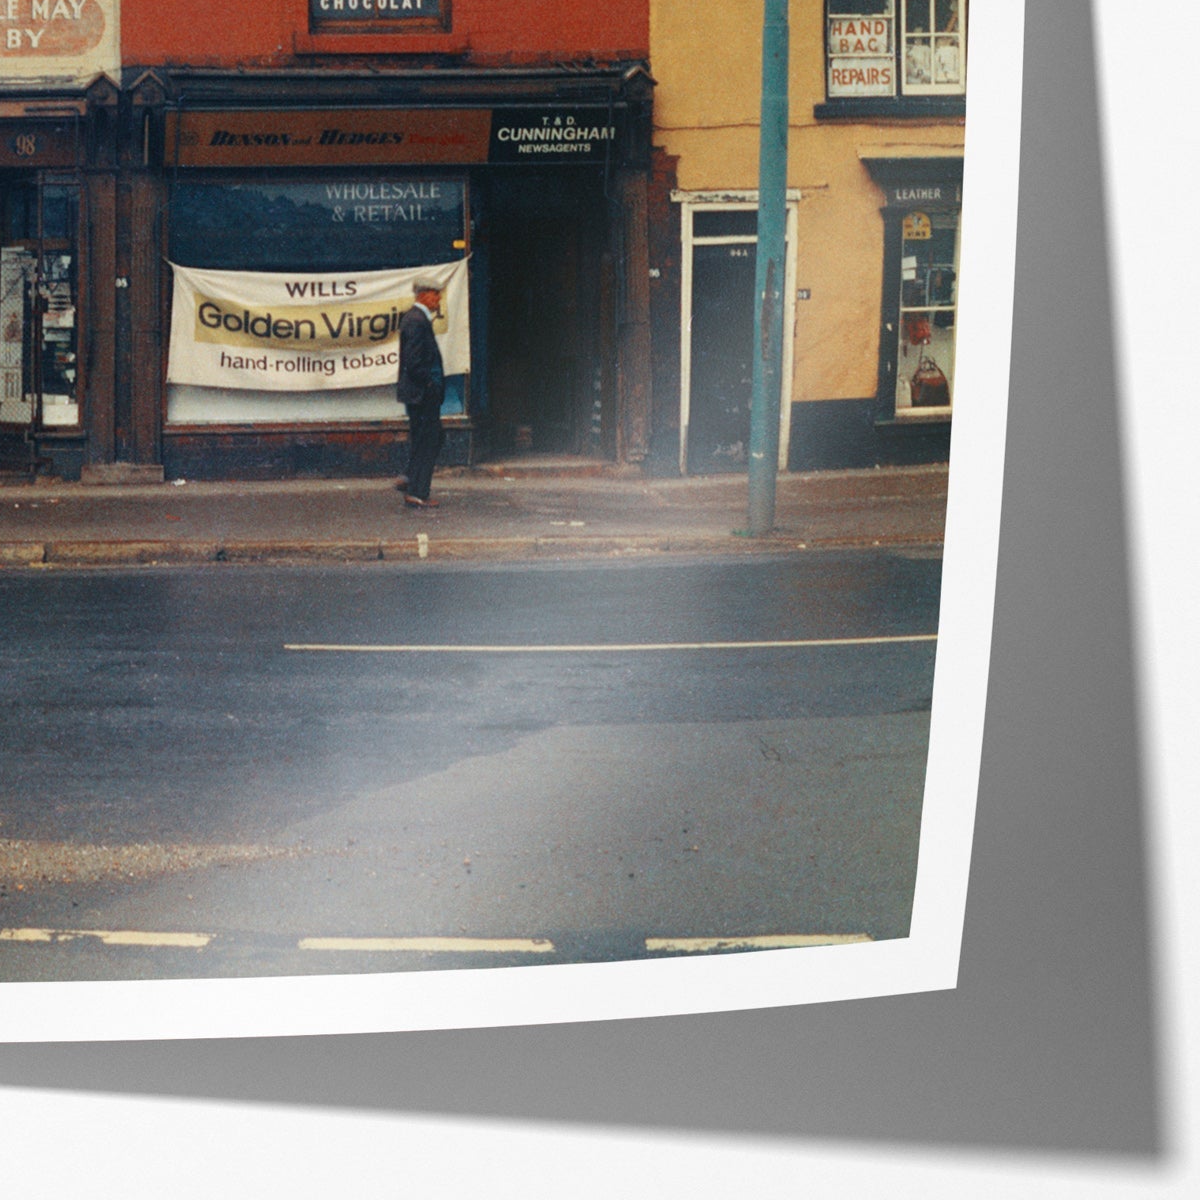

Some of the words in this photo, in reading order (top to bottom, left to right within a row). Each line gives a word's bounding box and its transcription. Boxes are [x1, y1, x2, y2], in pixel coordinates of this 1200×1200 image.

[832, 21, 885, 36] HAND
[7, 29, 45, 48] BY
[832, 68, 891, 86] REPAIRS
[554, 117, 562, 125] &
[518, 143, 591, 153] NEWSAGENTS
[326, 183, 441, 200] WHOLESALE
[896, 188, 941, 200] LEATHER
[332, 205, 346, 222] &
[285, 281, 358, 298] WILLS
[198, 302, 316, 340] Golden
[220, 351, 337, 376] hand-rolling
